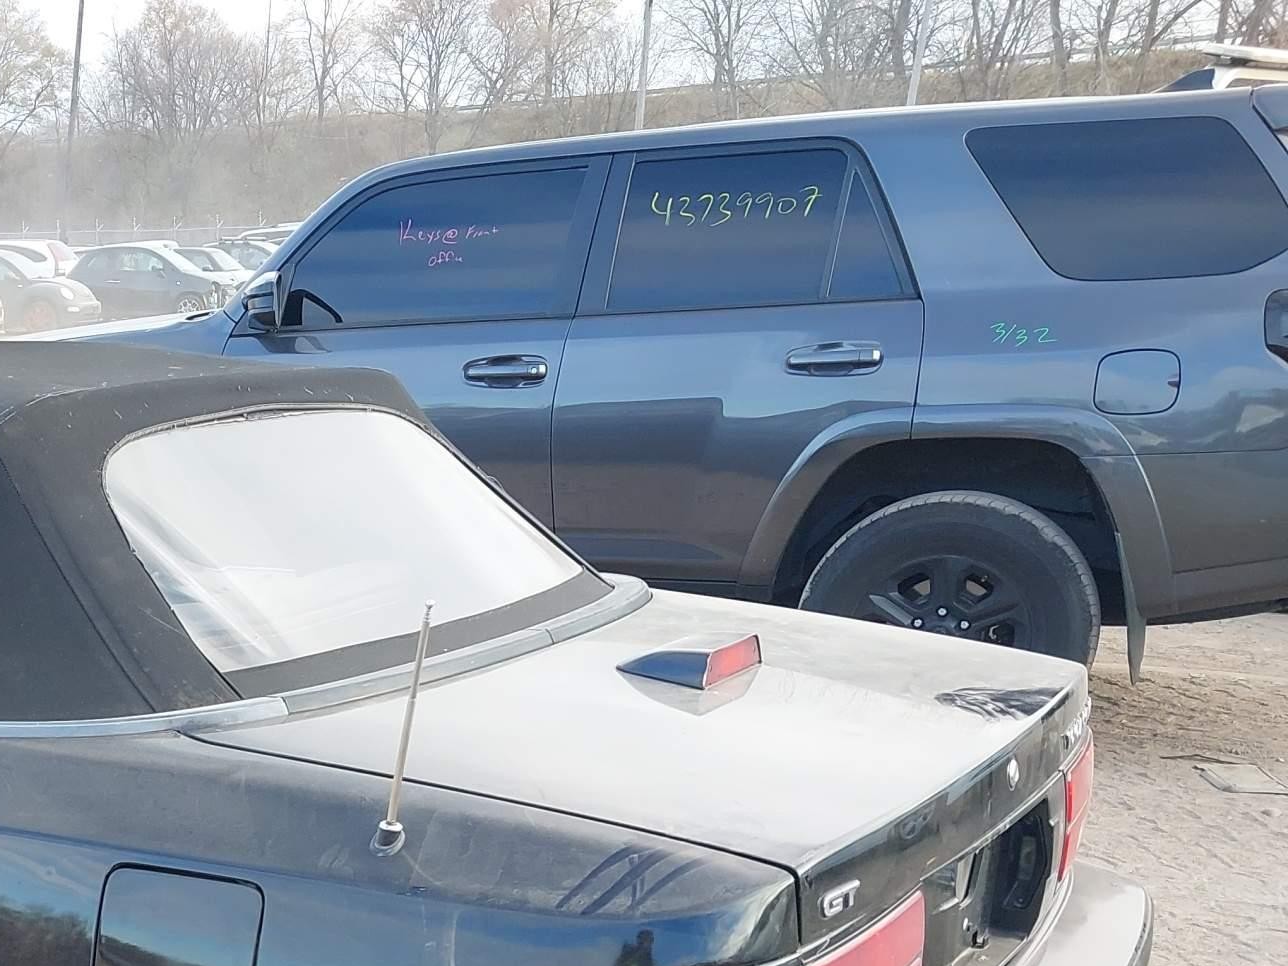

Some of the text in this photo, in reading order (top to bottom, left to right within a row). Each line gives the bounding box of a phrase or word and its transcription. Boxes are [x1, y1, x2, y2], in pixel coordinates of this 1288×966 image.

[650, 185, 824, 227] 43739907
[989, 322, 1058, 348] 3/32
[822, 879, 861, 918] GT
